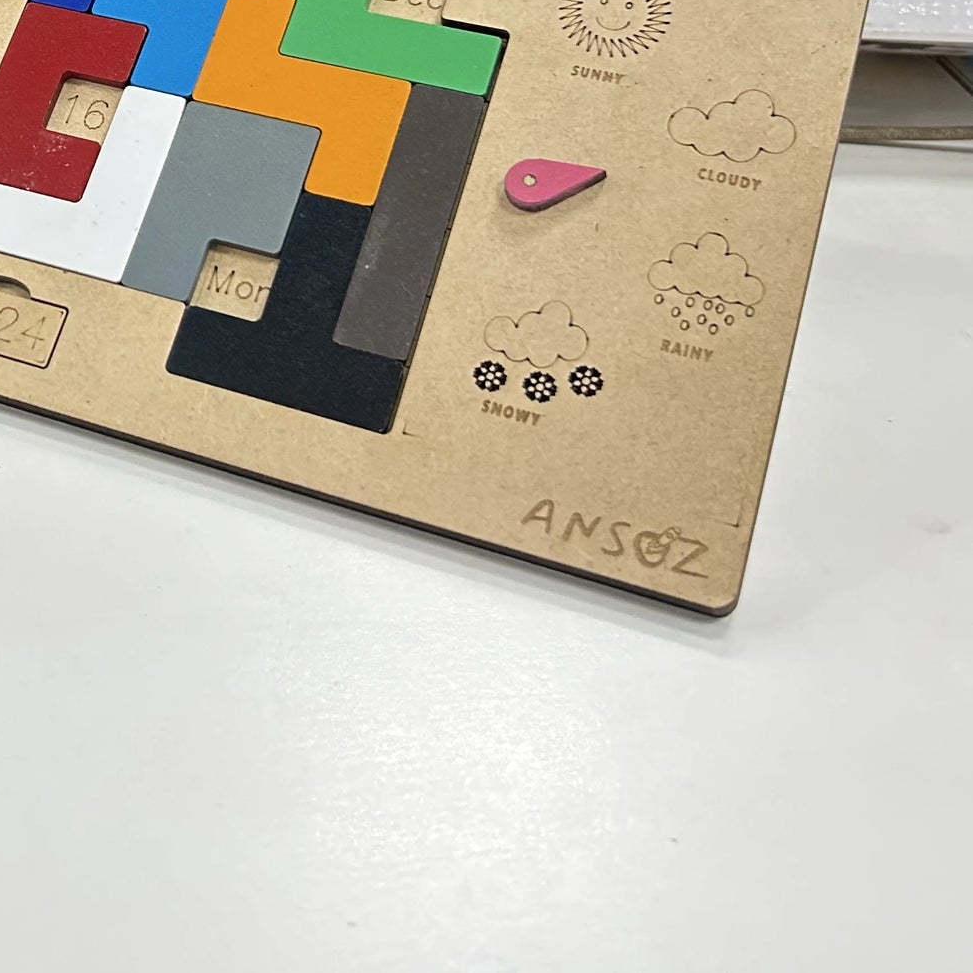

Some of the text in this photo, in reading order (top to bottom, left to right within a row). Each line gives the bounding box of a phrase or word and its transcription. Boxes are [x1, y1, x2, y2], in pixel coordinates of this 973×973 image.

[571, 65, 627, 85] SUNNY
[66, 93, 109, 131] 16
[697, 167, 763, 192] CLOUDY
[660, 339, 715, 362] RAINY
[481, 399, 543, 427] SNOWY
